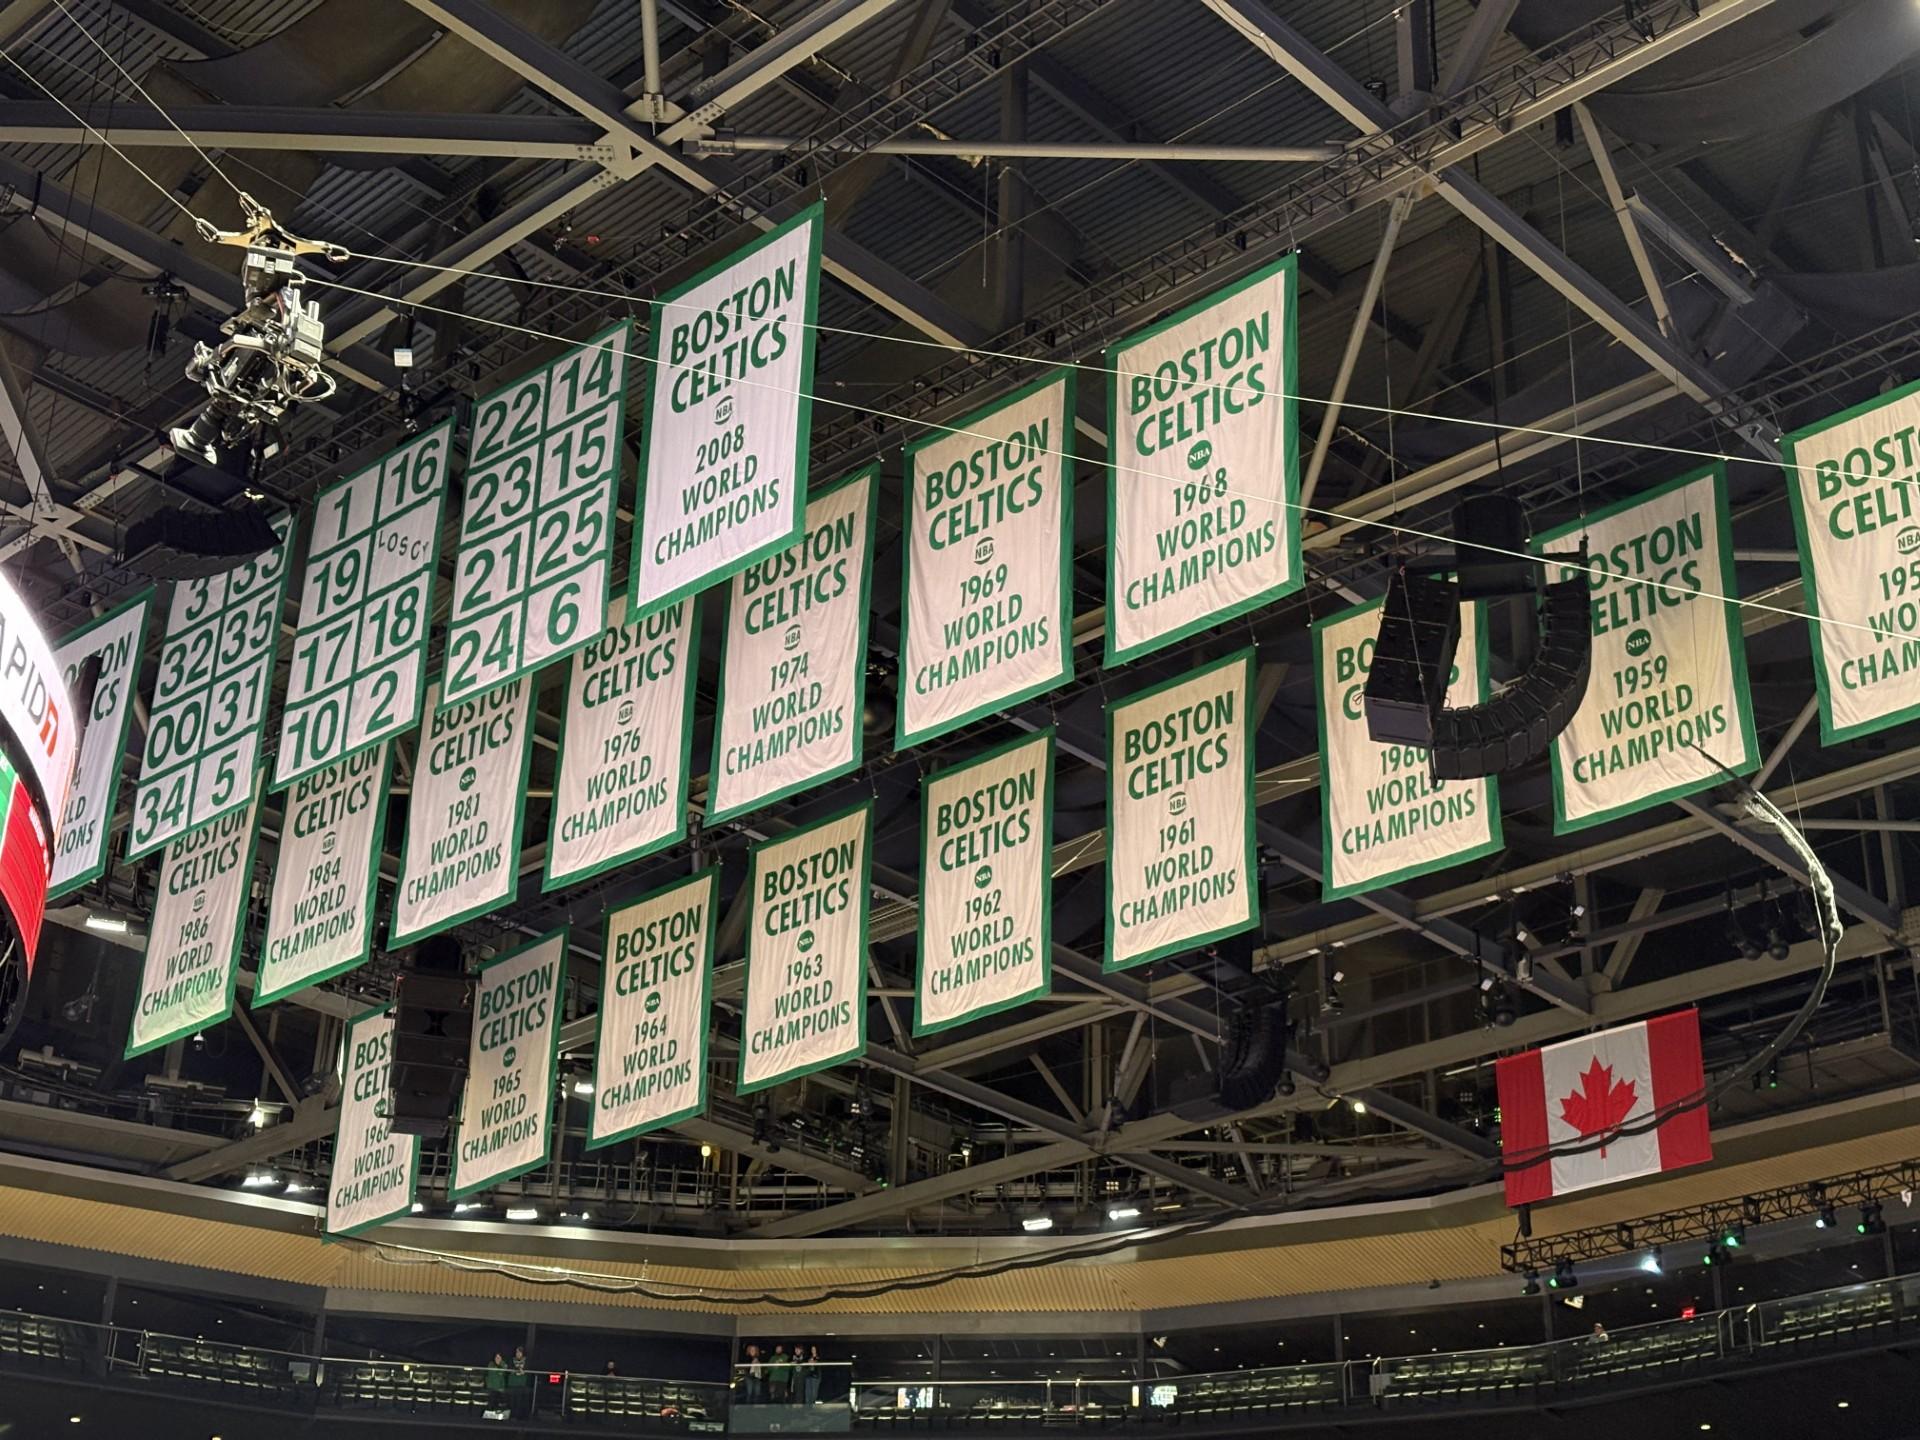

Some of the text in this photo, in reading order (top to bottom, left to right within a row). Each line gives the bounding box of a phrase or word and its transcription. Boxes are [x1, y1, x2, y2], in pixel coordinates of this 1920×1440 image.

[671, 259, 795, 368] BOSTON
[561, 341, 614, 415] 14
[671, 315, 786, 413] CELTICS
[1131, 311, 1269, 415] BOSTON
[477, 385, 540, 460] 22
[715, 401, 733, 419] NBA
[1136, 363, 1264, 457] CELTICS
[392, 438, 440, 506] 16
[553, 415, 606, 490] 15
[695, 425, 744, 473] 2008
[926, 418, 1048, 511] BOSTON
[1188, 447, 1211, 463] NBA
[1816, 425, 1920, 500] BOST
[334, 487, 352, 541] 1
[469, 457, 531, 532] 23
[682, 454, 757, 515] WORLD
[929, 466, 1042, 550] CELTICS
[1173, 467, 1227, 516] 1968
[537, 489, 604, 577] 25
[655, 479, 780, 565] CHAMPIONS
[1156, 499, 1246, 561] WORLD
[463, 534, 521, 612] 21
[743, 512, 855, 596] BOSTON
[976, 544, 994, 561] NBA
[1126, 521, 1275, 610] CHAMPIONS
[186, 577, 210, 621] 3
[313, 549, 360, 616] 19
[745, 558, 847, 635] CELTICS
[961, 564, 1008, 608] 1969
[1591, 560, 1702, 637] ELTICS
[222, 590, 276, 664] 35
[369, 586, 419, 657] 18
[548, 583, 580, 645] 6
[582, 601, 683, 670] BOSTON
[785, 632, 800, 645] NBA
[943, 594, 1022, 650] WORLD
[1628, 636, 1649, 650] NBA
[160, 629, 213, 696] 32
[299, 620, 352, 693] 17
[451, 612, 513, 696] 24
[582, 639, 675, 708] CELTICS
[770, 652, 809, 692] 1974
[915, 616, 1049, 695] CHAMPIONS
[1613, 655, 1667, 698] 1959
[214, 666, 261, 736] 31
[366, 670, 398, 735] 2
[431, 679, 521, 740] BOSTON
[619, 707, 633, 720] NBA
[753, 682, 821, 733] WORLD
[1124, 690, 1233, 764] BOSTON
[1601, 684, 1692, 739] WORLD
[147, 701, 201, 769] 00
[288, 699, 339, 770] 10
[429, 708, 514, 776] CELTICS
[604, 727, 640, 764] 1976
[726, 706, 843, 775] CHAMPIONS
[1573, 705, 1727, 784] CHAMPIONS
[212, 749, 238, 806] 5
[296, 744, 381, 803] BOSTON
[587, 755, 651, 802] WORLD
[1128, 732, 1228, 800] CELTICS
[136, 774, 186, 844] 34
[294, 775, 372, 838] CELTICS
[448, 792, 481, 828] 1981
[561, 778, 668, 842] CHAMPIONS
[937, 768, 1035, 837] BOSTON
[1170, 798, 1186, 810] NBA
[1342, 789, 1475, 855] CHAMPIONS
[171, 806, 249, 861] BOSTON
[431, 821, 488, 866] WORLD
[939, 809, 1030, 872] CELTICS
[1160, 818, 1195, 853] 1961
[169, 836, 241, 896] CELTICS
[308, 857, 341, 891] 1984
[407, 843, 501, 905] CHAMPIONS
[763, 840, 856, 902] BOSTON
[1144, 845, 1213, 890] WORLD
[293, 884, 346, 926] WORLD
[765, 878, 849, 936] CELTICS
[965, 889, 1001, 923] 1962
[1120, 869, 1236, 928] CHAMPIONS
[179, 916, 209, 947] 1986
[270, 905, 356, 964] CHAMPIONS
[615, 904, 701, 964] BOSTON
[951, 916, 1013, 958] WORLD
[165, 942, 212, 981] WORLD
[480, 962, 553, 1020] BOSTON
[615, 941, 695, 996] CELTICS
[787, 954, 823, 986] 1963
[931, 937, 1033, 995] CHAMPIONS
[142, 966, 223, 1017] CHAMPIONS
[775, 980, 832, 1019] WORLD
[355, 1032, 391, 1071] BOS
[480, 998, 546, 1052] CELTICS
[634, 1015, 668, 1045] 1964
[752, 1001, 850, 1054] CHAMPIONS
[354, 1063, 390, 1102] CELT
[492, 1069, 521, 1100] 1965
[601, 1059, 691, 1110] CHAMPIONS
[623, 1039, 677, 1077] WORLD
[462, 1114, 538, 1162] CHAMPIONS
[481, 1093, 526, 1130] WORLD
[336, 1164, 404, 1208] CHAMPIONS
[354, 1144, 394, 1178] WORLD
